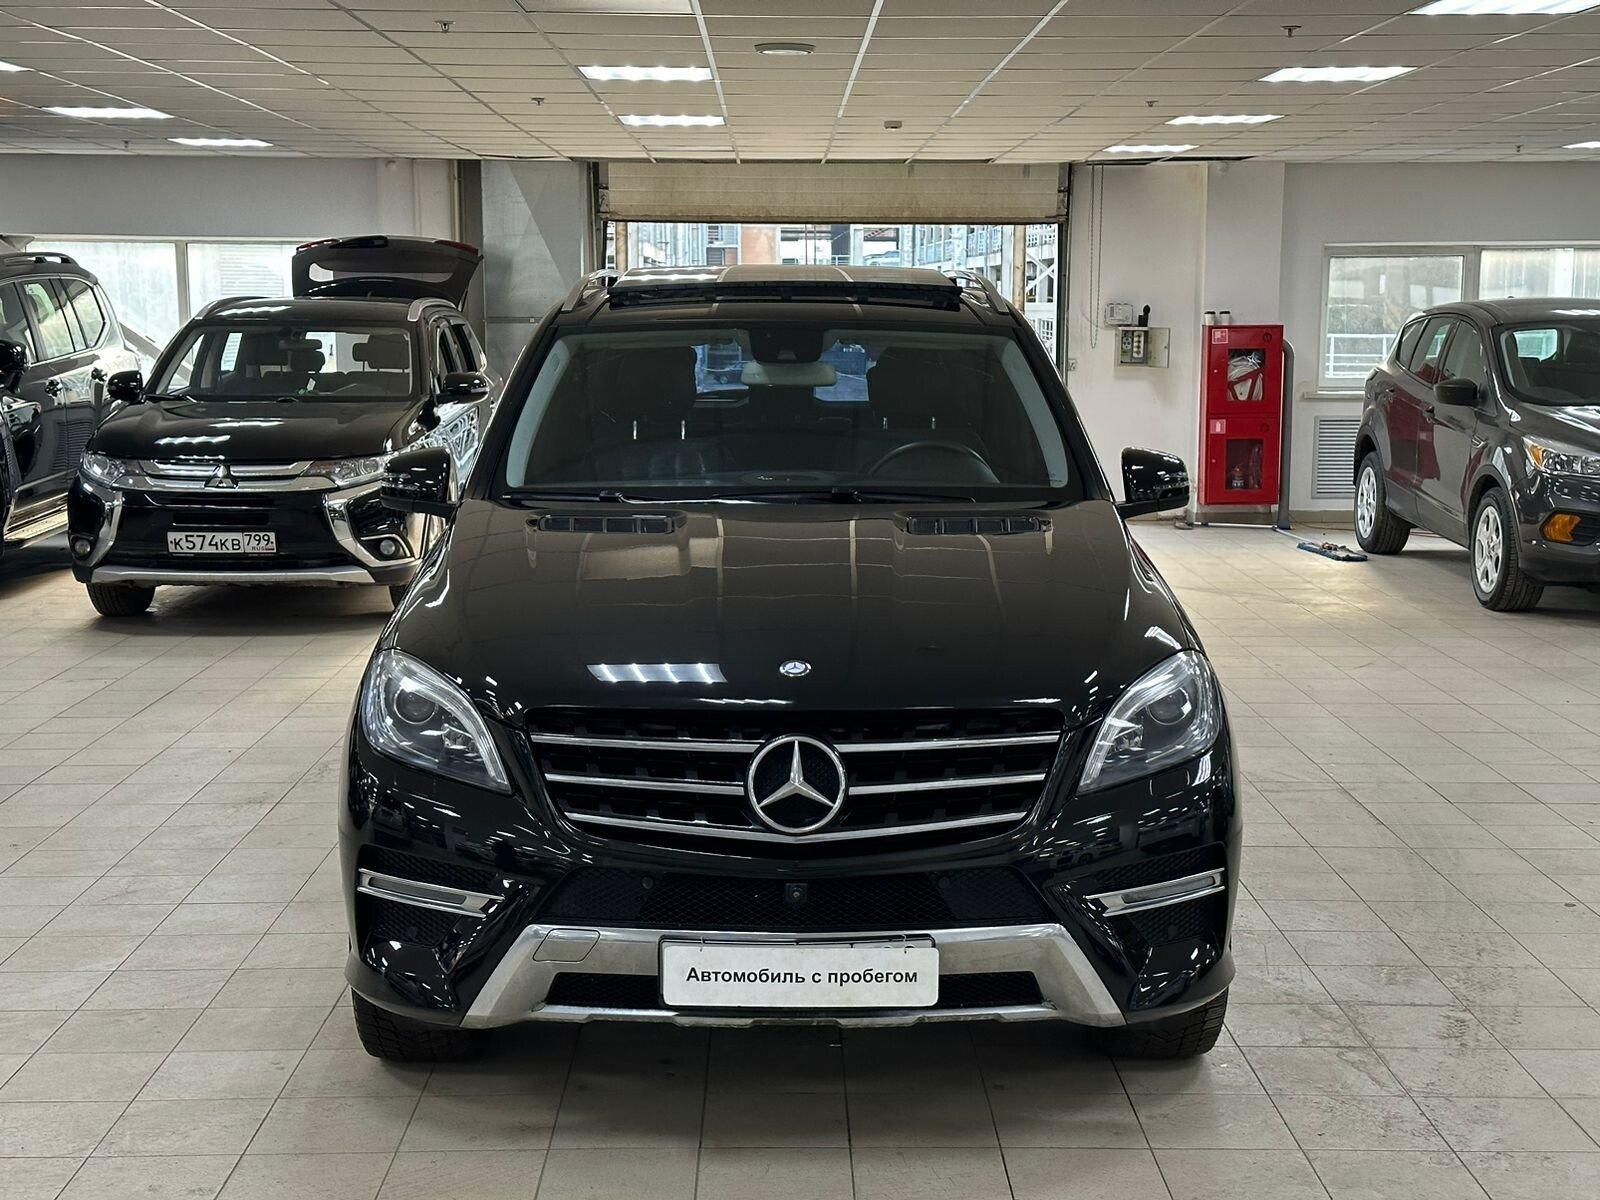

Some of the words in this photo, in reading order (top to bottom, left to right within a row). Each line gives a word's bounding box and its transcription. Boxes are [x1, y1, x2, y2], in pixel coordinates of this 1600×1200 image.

[244, 533, 271, 546] 799
[686, 967, 805, 984] Автомобиль
[811, 970, 822, 983] с
[827, 968, 918, 987] пробегом
